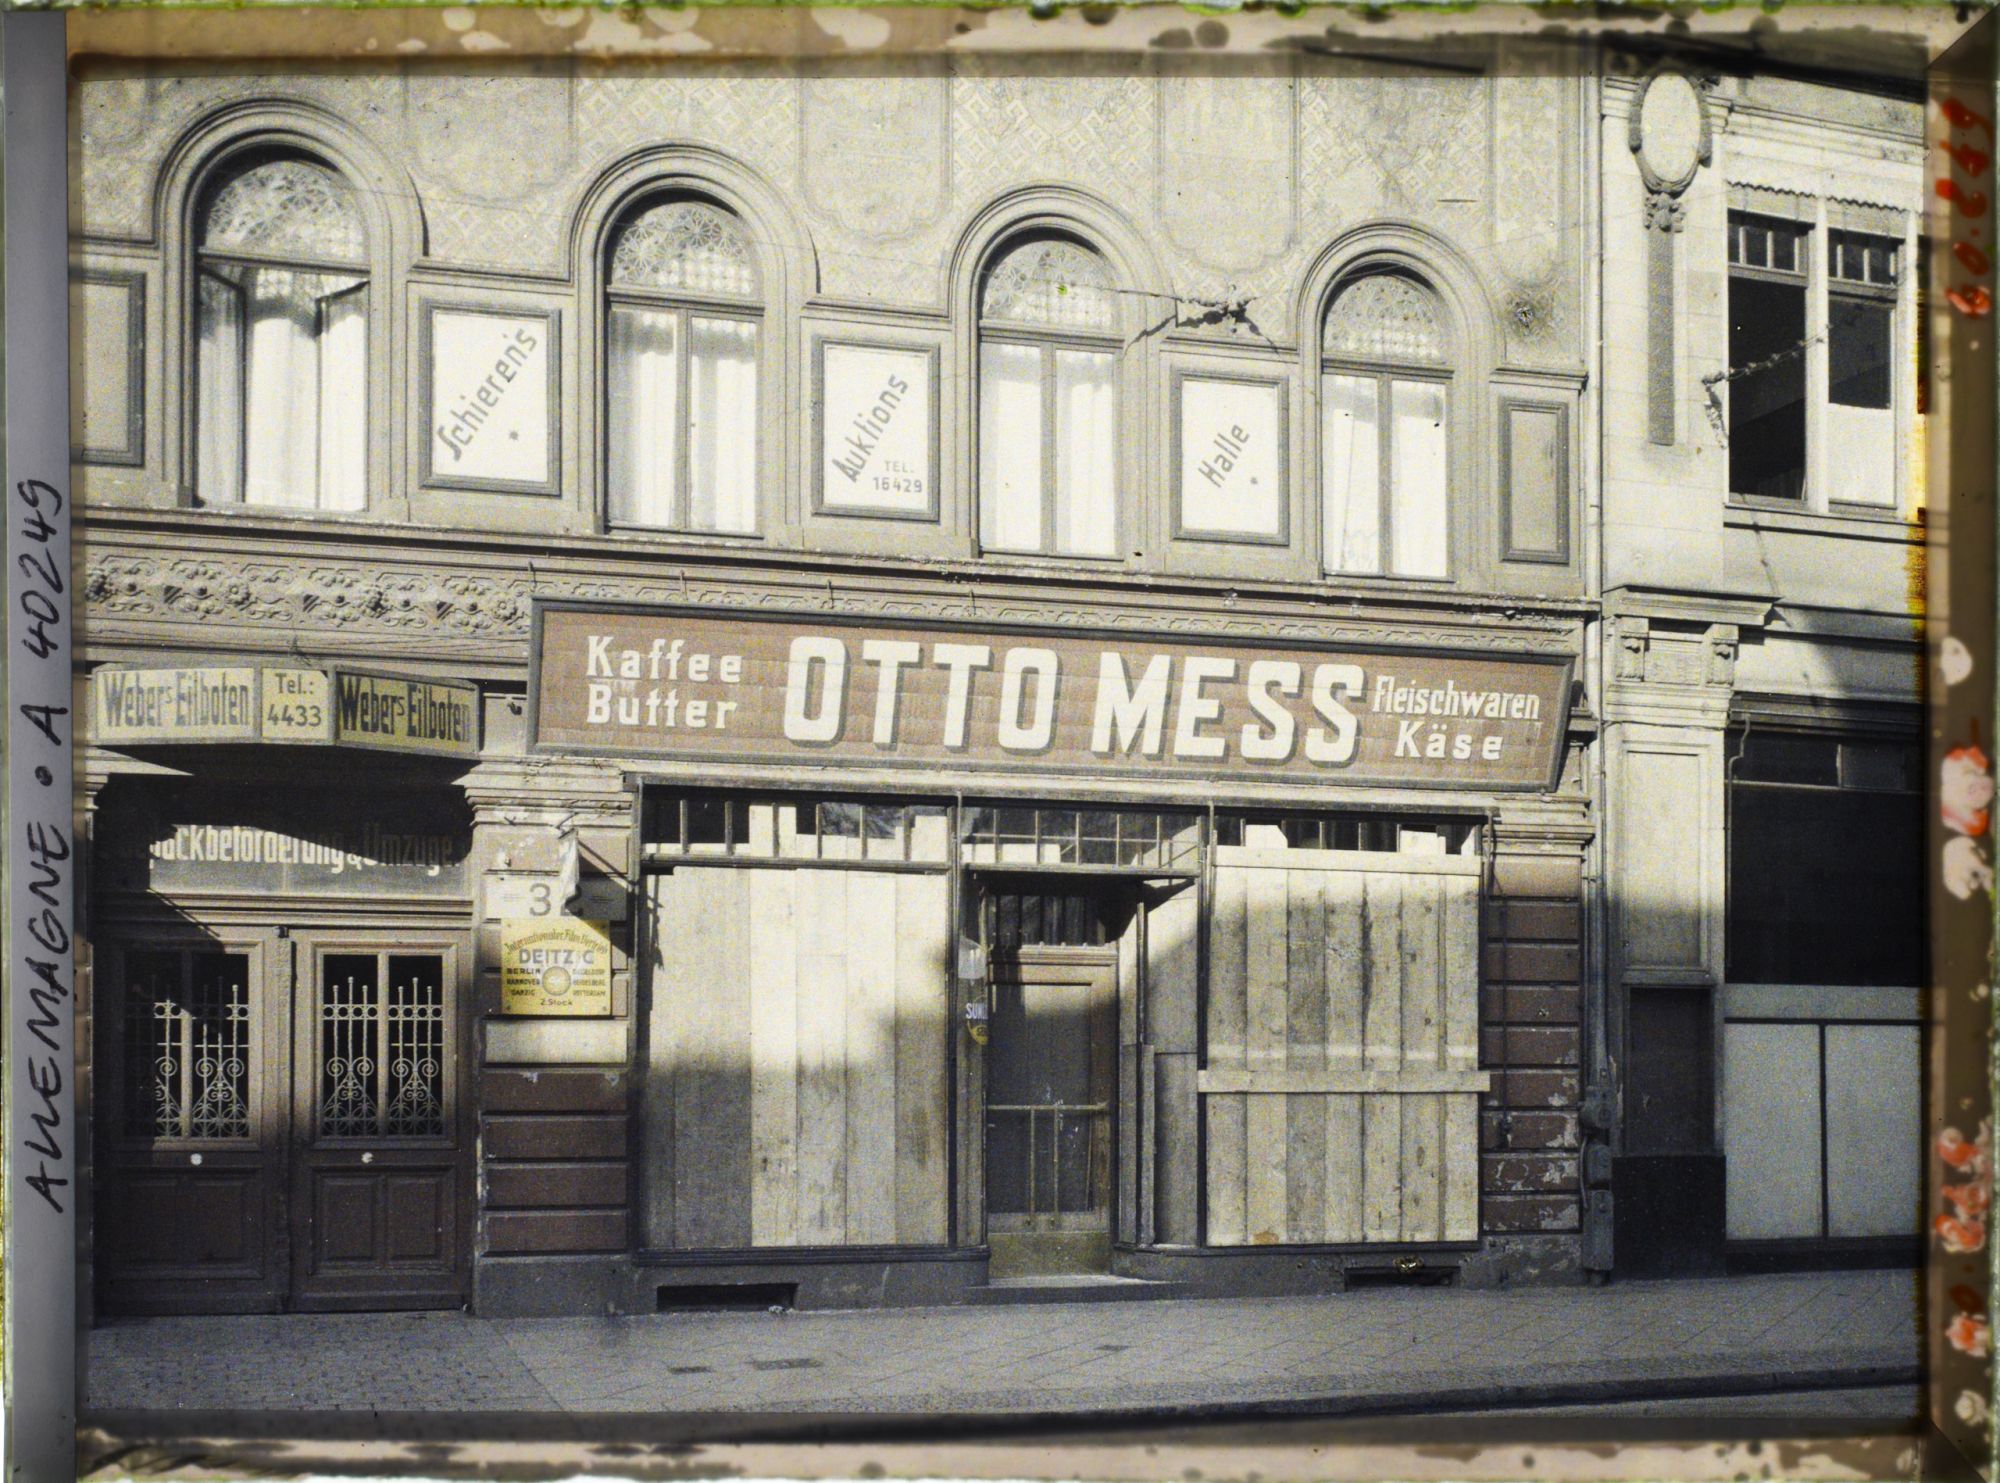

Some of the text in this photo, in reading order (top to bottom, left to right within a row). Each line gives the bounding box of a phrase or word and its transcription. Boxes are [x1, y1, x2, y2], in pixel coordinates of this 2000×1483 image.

[832, 374, 908, 483] Auktions
[884, 460, 915, 473] TEL.
[1198, 424, 1250, 488] Halle
[873, 476, 922, 493] 16429
[587, 635, 742, 683] Kaffee
[175, 671, 249, 727] Eilboten
[275, 673, 314, 695] Tel.:
[586, 684, 738, 729] Butter
[783, 635, 1366, 763] OTTO MESS
[1372, 675, 1541, 720] Fleischwaren
[267, 704, 322, 727] 4433
[406, 682, 471, 743] Eilboten
[1394, 720, 1503, 761] Käse
[16, 479, 69, 1214] ALLEMAGNE A 40249
[519, 949, 574, 964] DEITZ
